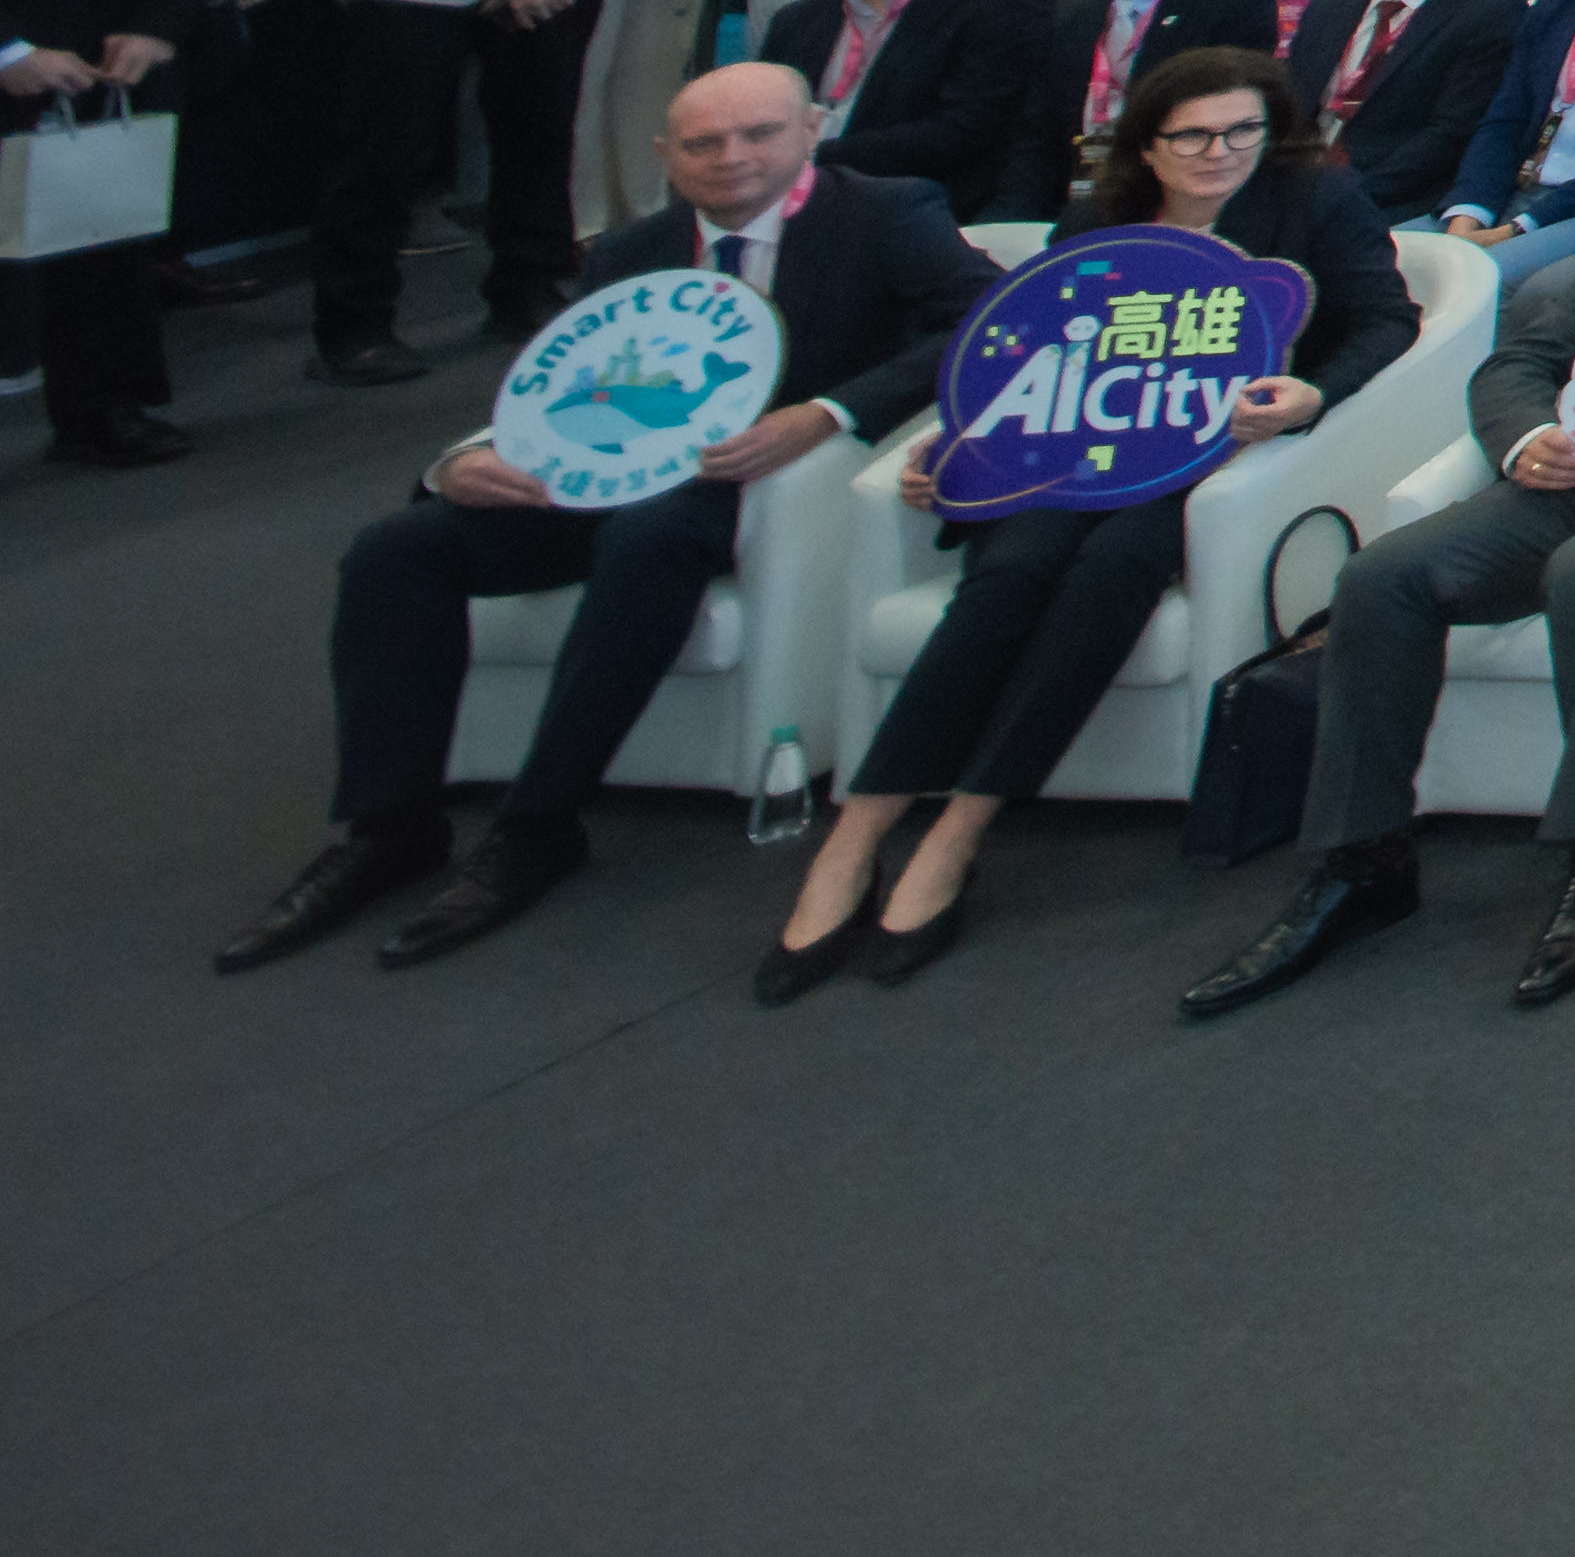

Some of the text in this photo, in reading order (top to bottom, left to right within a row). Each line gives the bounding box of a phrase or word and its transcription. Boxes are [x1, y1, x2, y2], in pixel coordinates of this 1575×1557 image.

[510, 280, 753, 397] Smart City
[1097, 286, 1247, 362] 高雄
